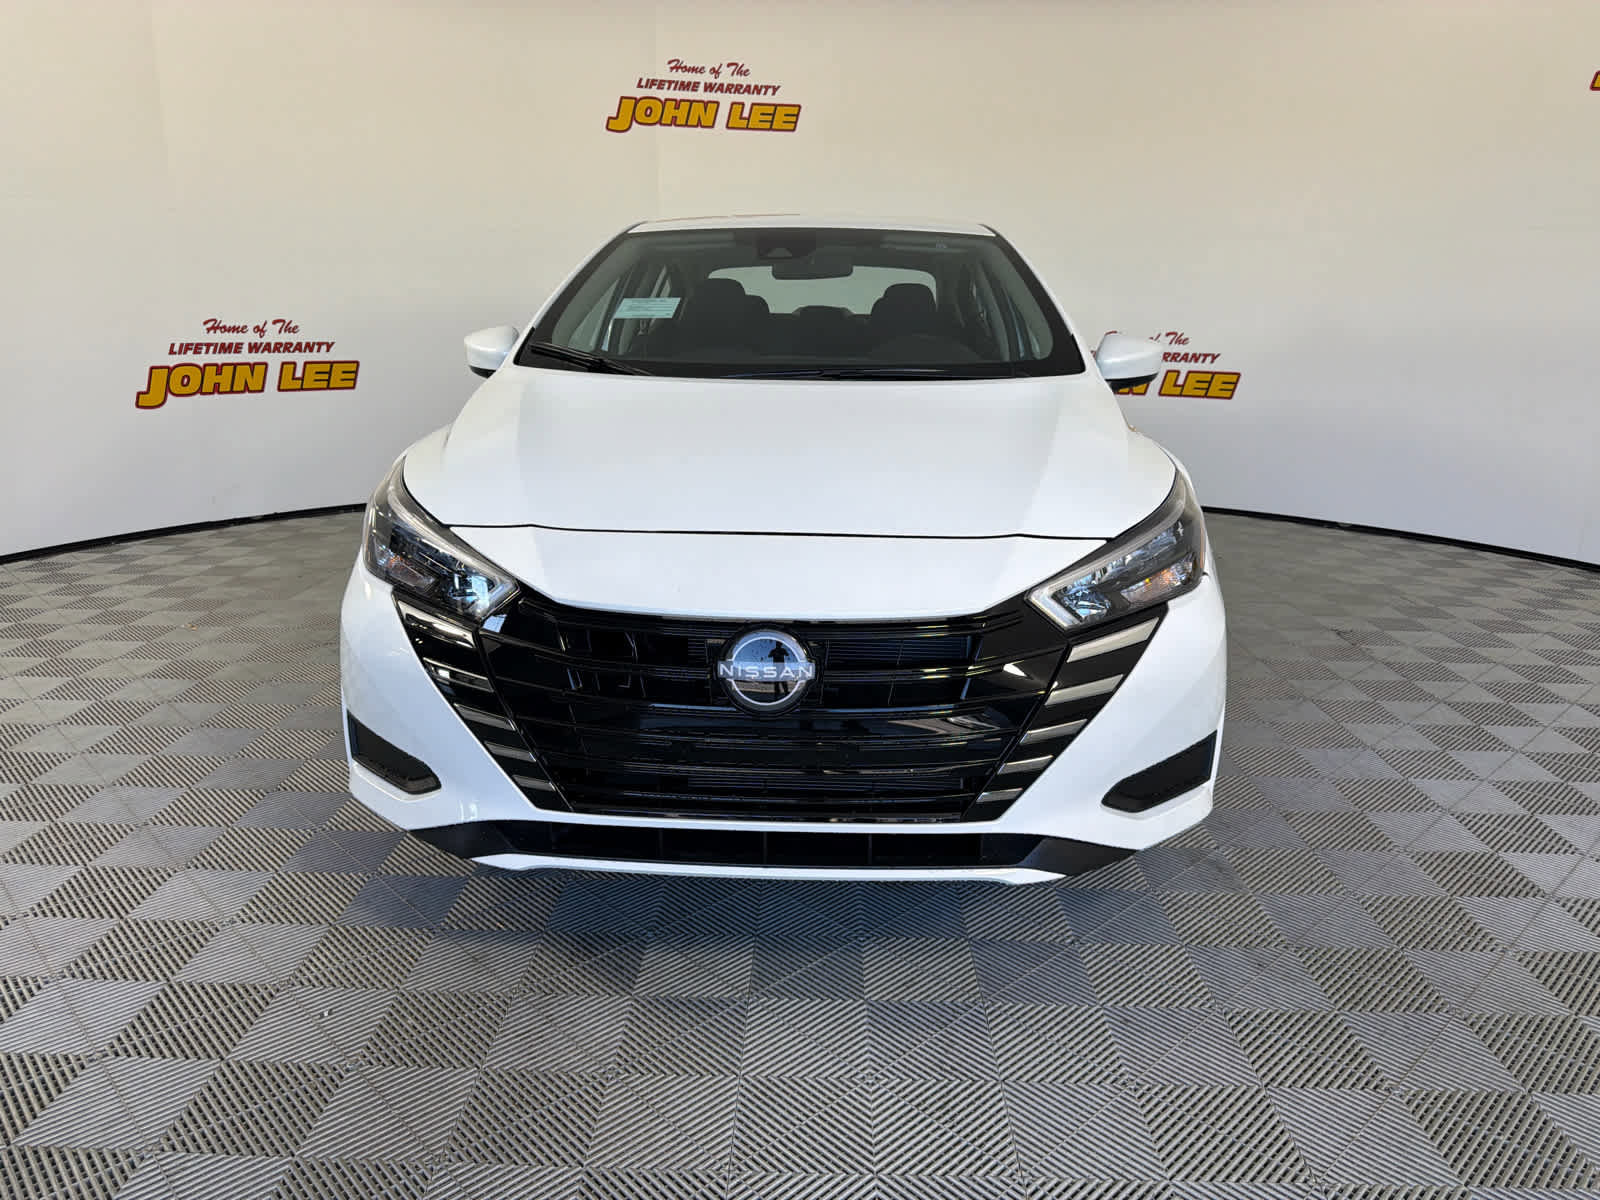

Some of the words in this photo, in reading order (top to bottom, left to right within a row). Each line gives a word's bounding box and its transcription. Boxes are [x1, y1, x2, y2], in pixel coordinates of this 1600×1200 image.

[667, 58, 705, 75] Home
[709, 63, 722, 79] of
[727, 62, 750, 77] The
[636, 77, 700, 92] LIFETIME
[703, 81, 781, 96] WARRANTY
[606, 95, 720, 134] JOHN
[726, 101, 802, 132] LEE
[203, 318, 248, 335] Home
[253, 319, 267, 339] of
[272, 319, 300, 335] The
[1165, 331, 1190, 346] The
[168, 342, 244, 356] LIFETIME
[248, 341, 336, 355] WARRANTY
[1161, 351, 1221, 364] RRANTY
[136, 361, 268, 410] JOHN
[277, 360, 360, 392] LEE
[1158, 369, 1241, 400] LEE
[719, 662, 813, 679] NISSAN
